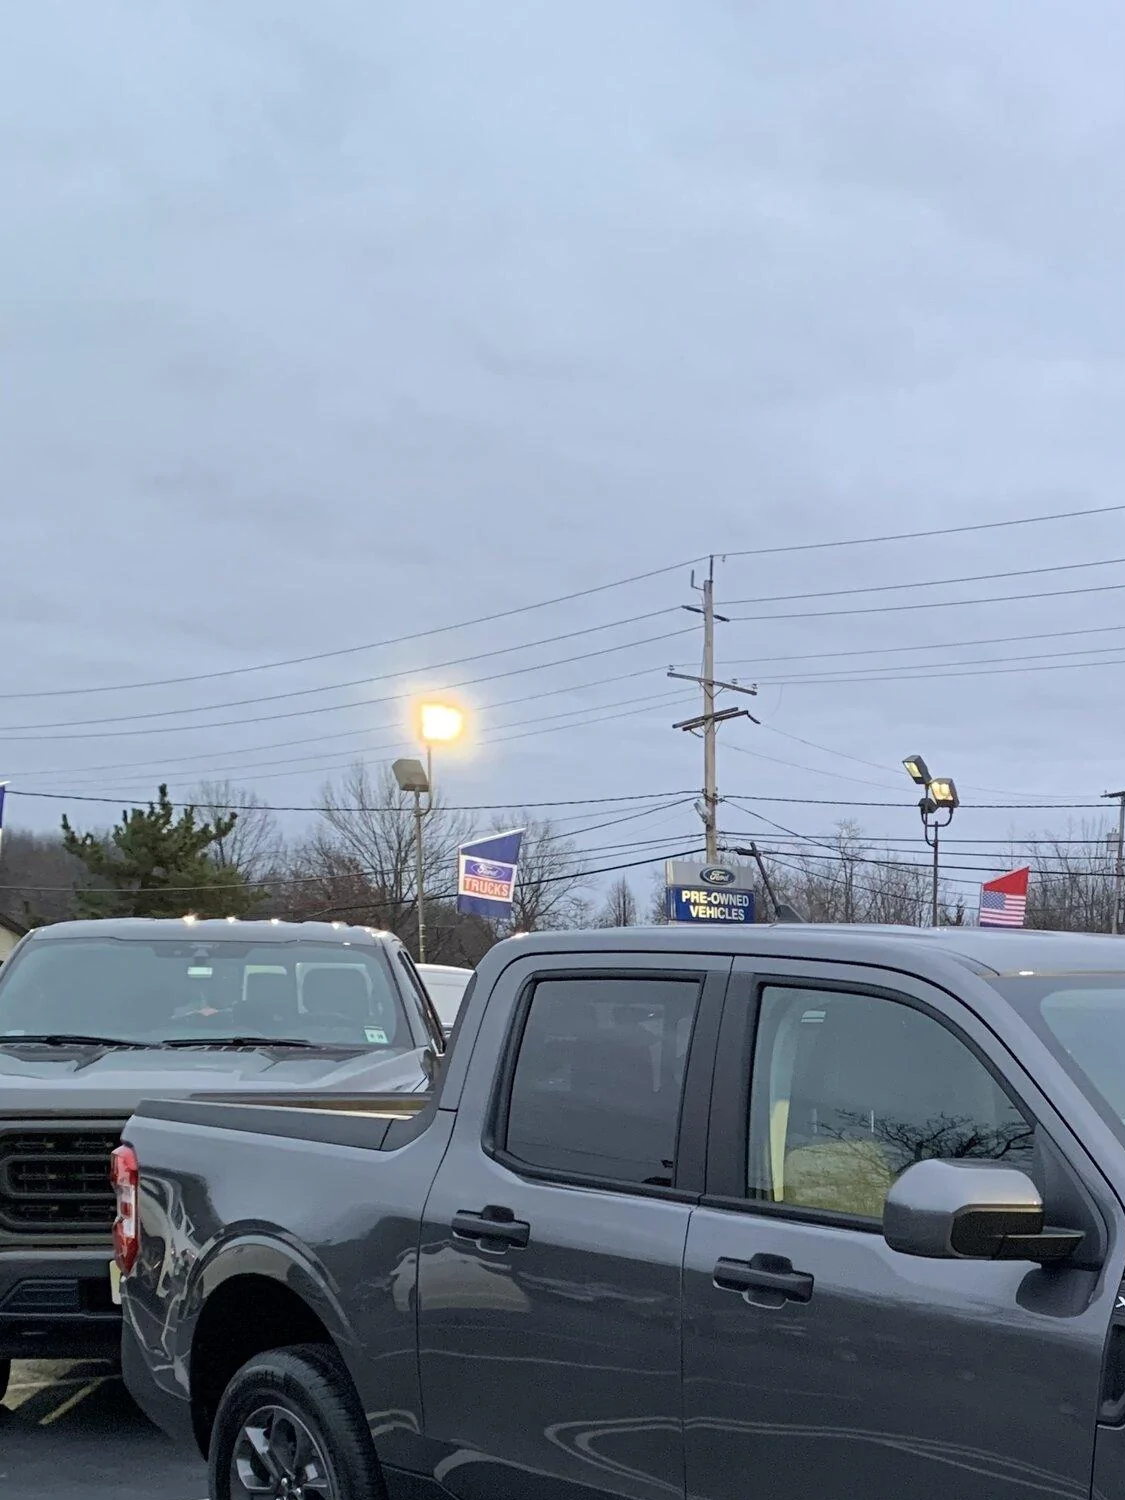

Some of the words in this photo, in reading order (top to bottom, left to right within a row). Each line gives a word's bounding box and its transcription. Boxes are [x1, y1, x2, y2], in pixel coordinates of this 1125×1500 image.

[709, 870, 729, 881] Ford
[464, 878, 510, 897] TRUCKS
[681, 890, 750, 907] PRE-OWNED
[689, 905, 745, 921] VEHICLES
